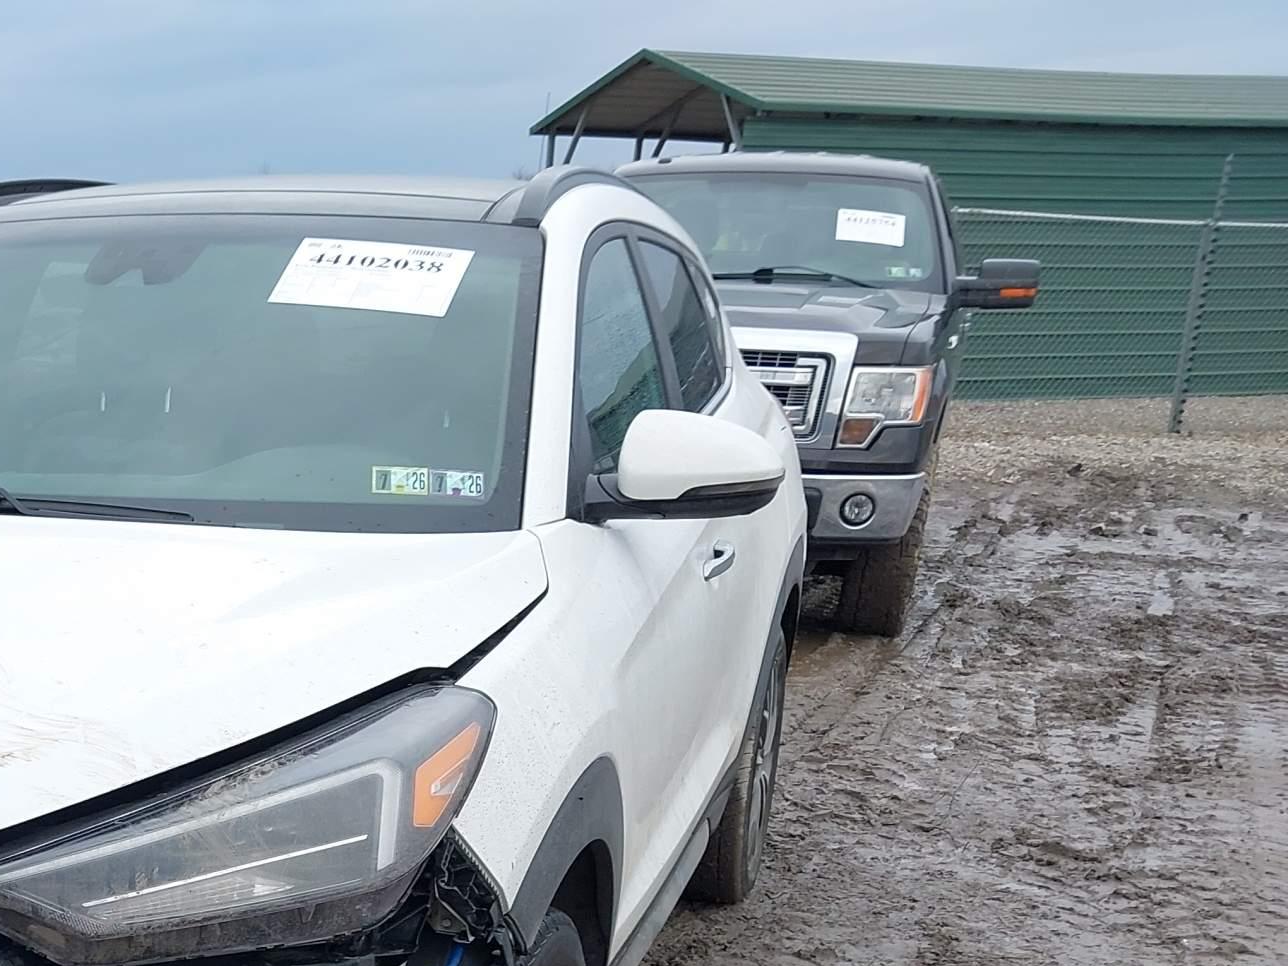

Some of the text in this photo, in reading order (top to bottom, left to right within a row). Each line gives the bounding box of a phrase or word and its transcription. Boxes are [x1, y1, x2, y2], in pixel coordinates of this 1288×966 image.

[308, 252, 444, 273] 44102038
[412, 472, 426, 490] 26
[468, 475, 482, 493] 26
